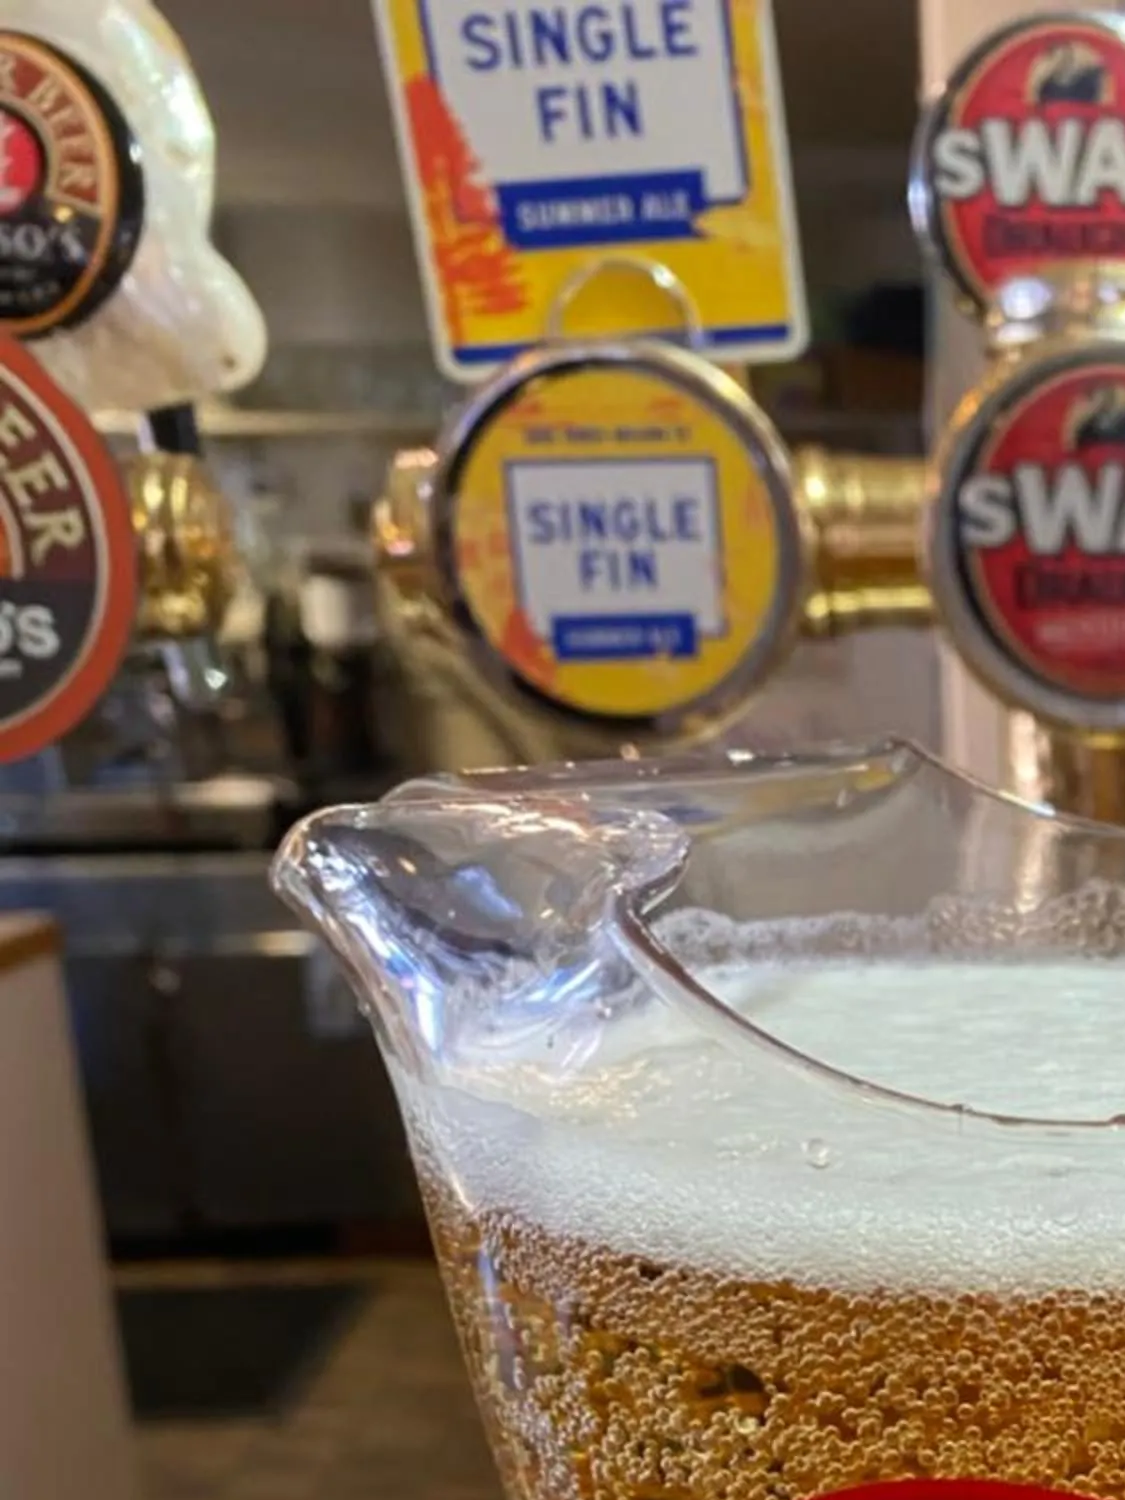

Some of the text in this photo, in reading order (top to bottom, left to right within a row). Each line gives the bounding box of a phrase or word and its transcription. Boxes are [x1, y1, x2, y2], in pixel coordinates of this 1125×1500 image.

[461, 1, 698, 71] SINGLE
[537, 82, 643, 142] FIN
[527, 499, 700, 544] SINGLE
[578, 549, 658, 591] FIN
